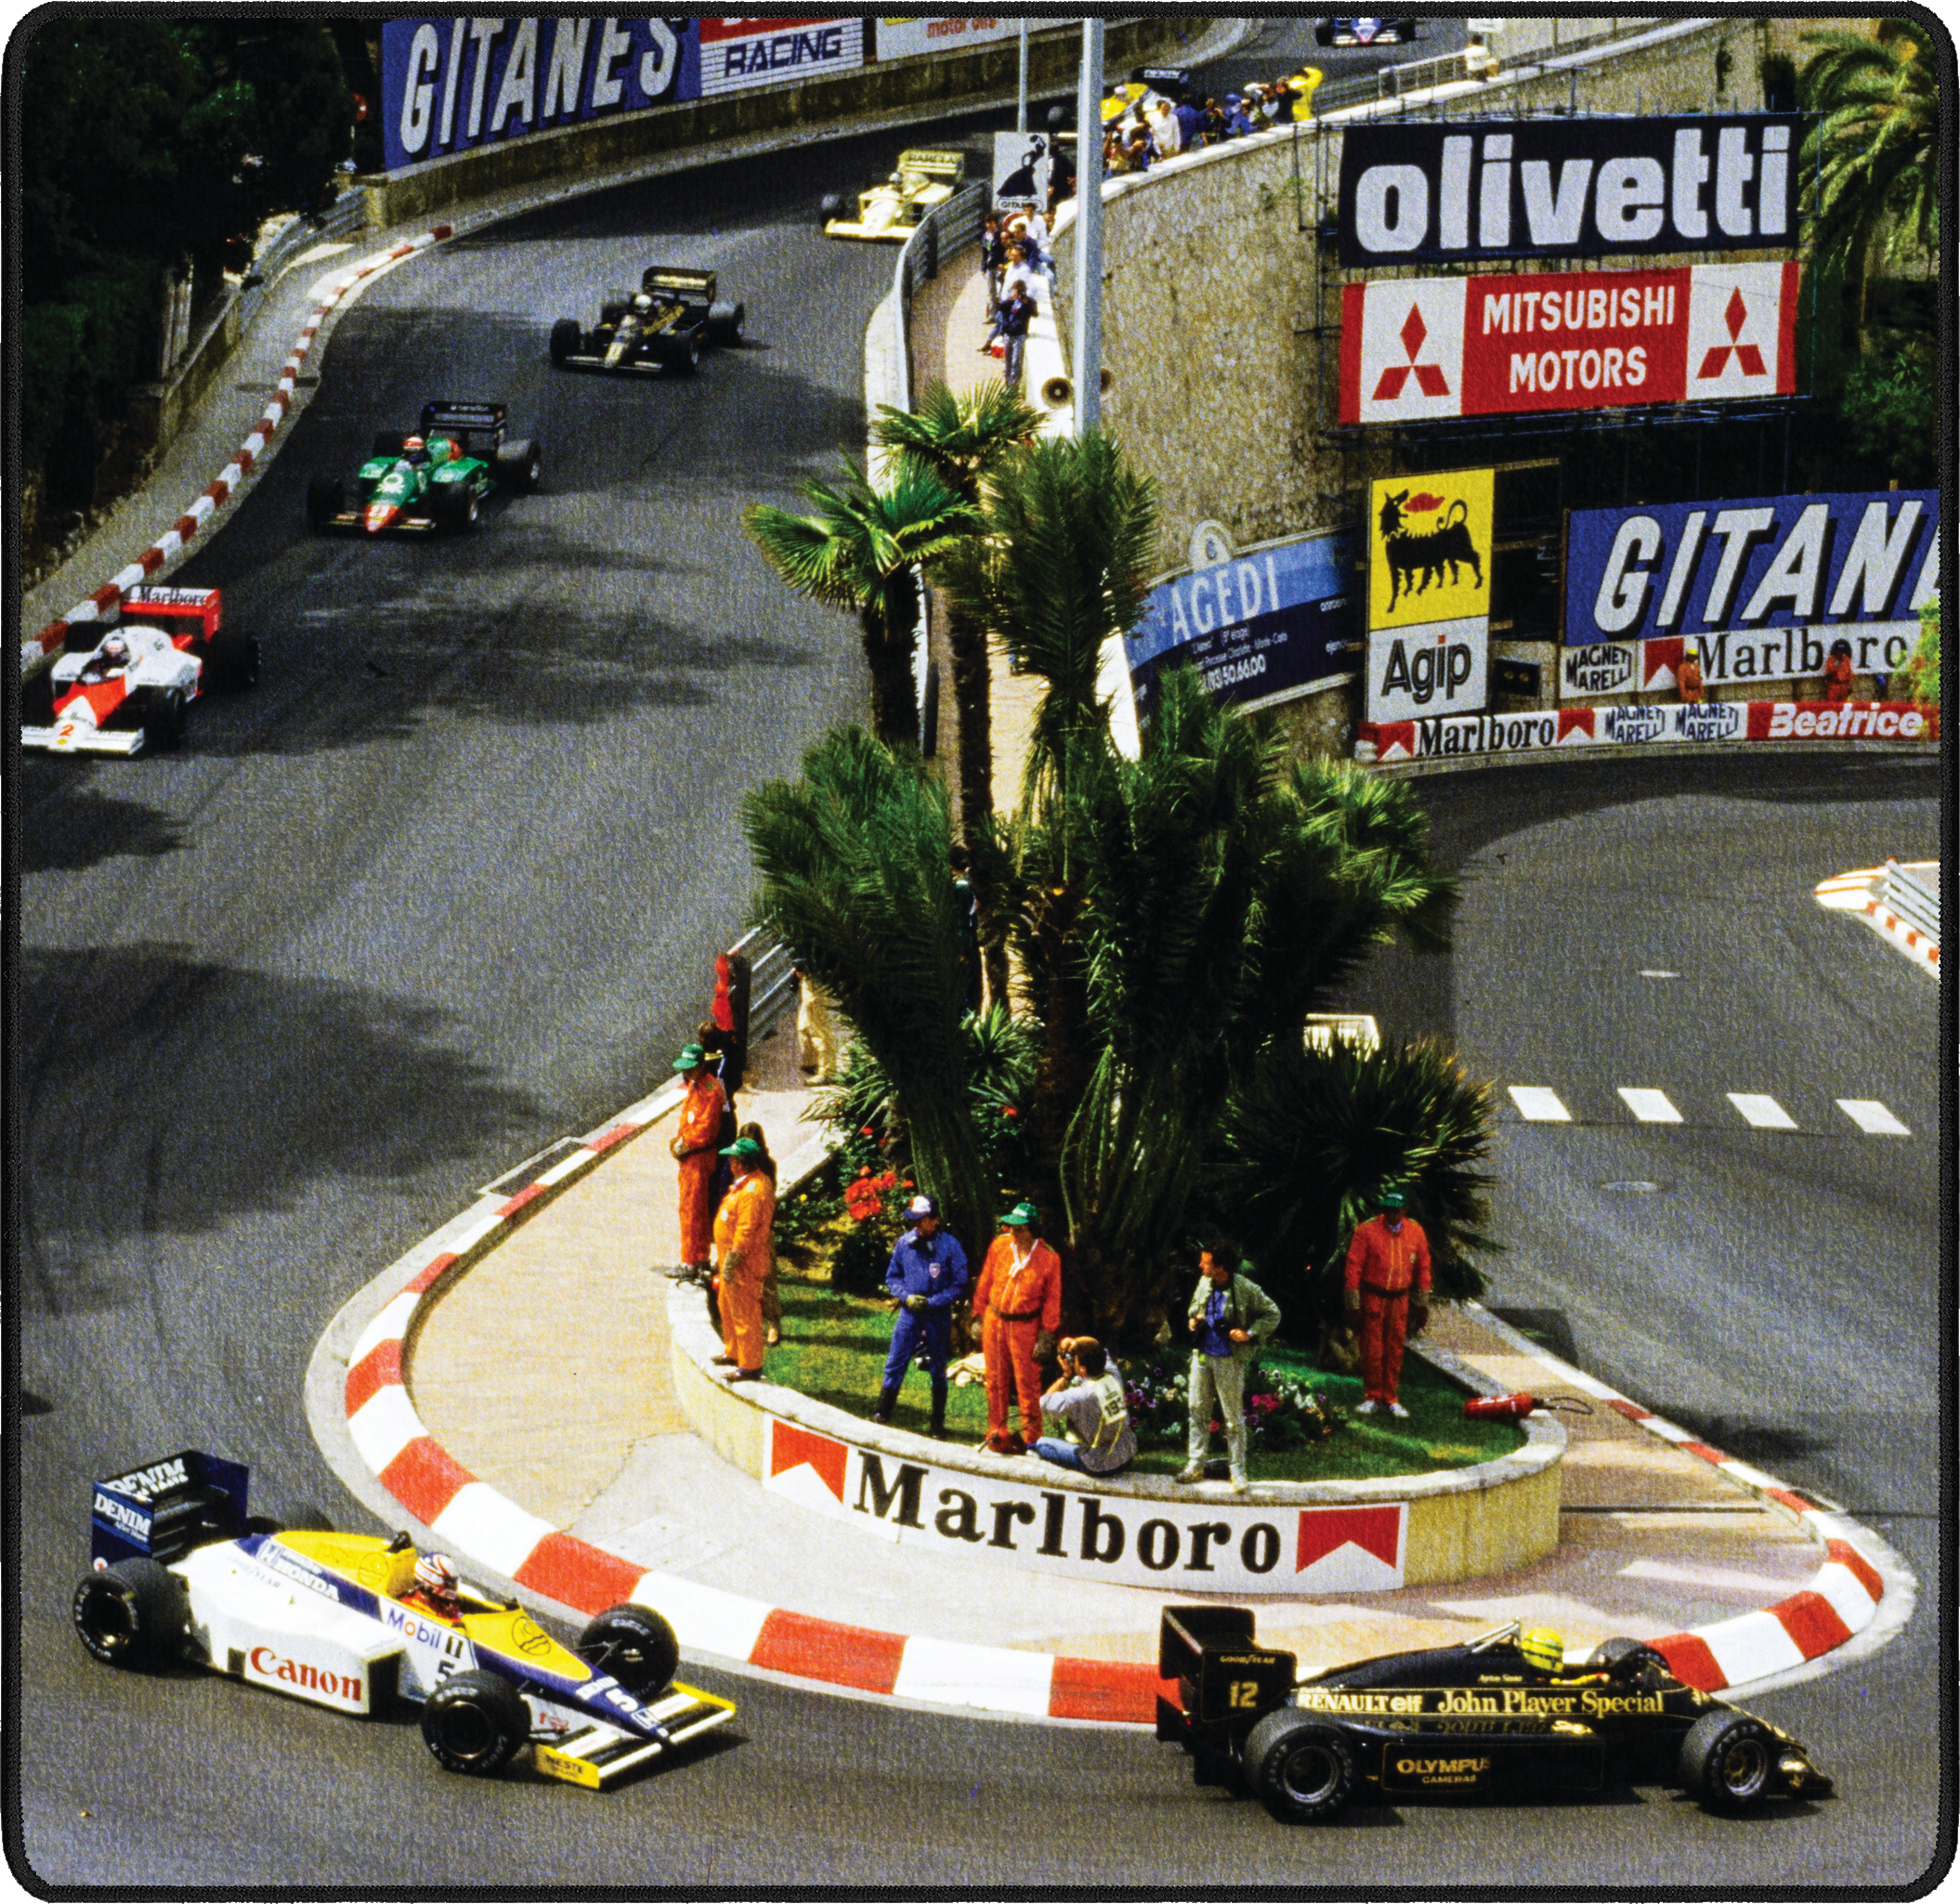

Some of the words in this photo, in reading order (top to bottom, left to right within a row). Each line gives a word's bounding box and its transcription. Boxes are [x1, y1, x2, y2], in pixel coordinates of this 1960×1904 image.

[725, 27, 843, 77] RACING
[400, 18, 683, 153] GITANES
[1355, 126, 1790, 252] olivetti
[1483, 286, 1675, 334] MITSUBISHI
[1509, 346, 1647, 394] MOTORS
[1380, 634, 1472, 704] Agip
[1694, 628, 1908, 680] Marlbro
[59, 724, 74, 737] 2
[1415, 714, 1555, 757] Marlboro
[1768, 701, 1924, 737] Beatrice
[94, 1492, 152, 1536] DENIM
[852, 1450, 1281, 1574] Marlboro
[386, 1608, 442, 1650] Mobil
[250, 1647, 362, 1702] Canon
[434, 1660, 456, 1689] 5
[1229, 1680, 1260, 1708] 12
[605, 1688, 639, 1713] 5
[1298, 1692, 1390, 1713] RENAULT
[1390, 1695, 1423, 1714] elf
[1438, 1690, 1499, 1714] John
[1503, 1689, 1577, 1718] Player
[1581, 1690, 1665, 1719] Special
